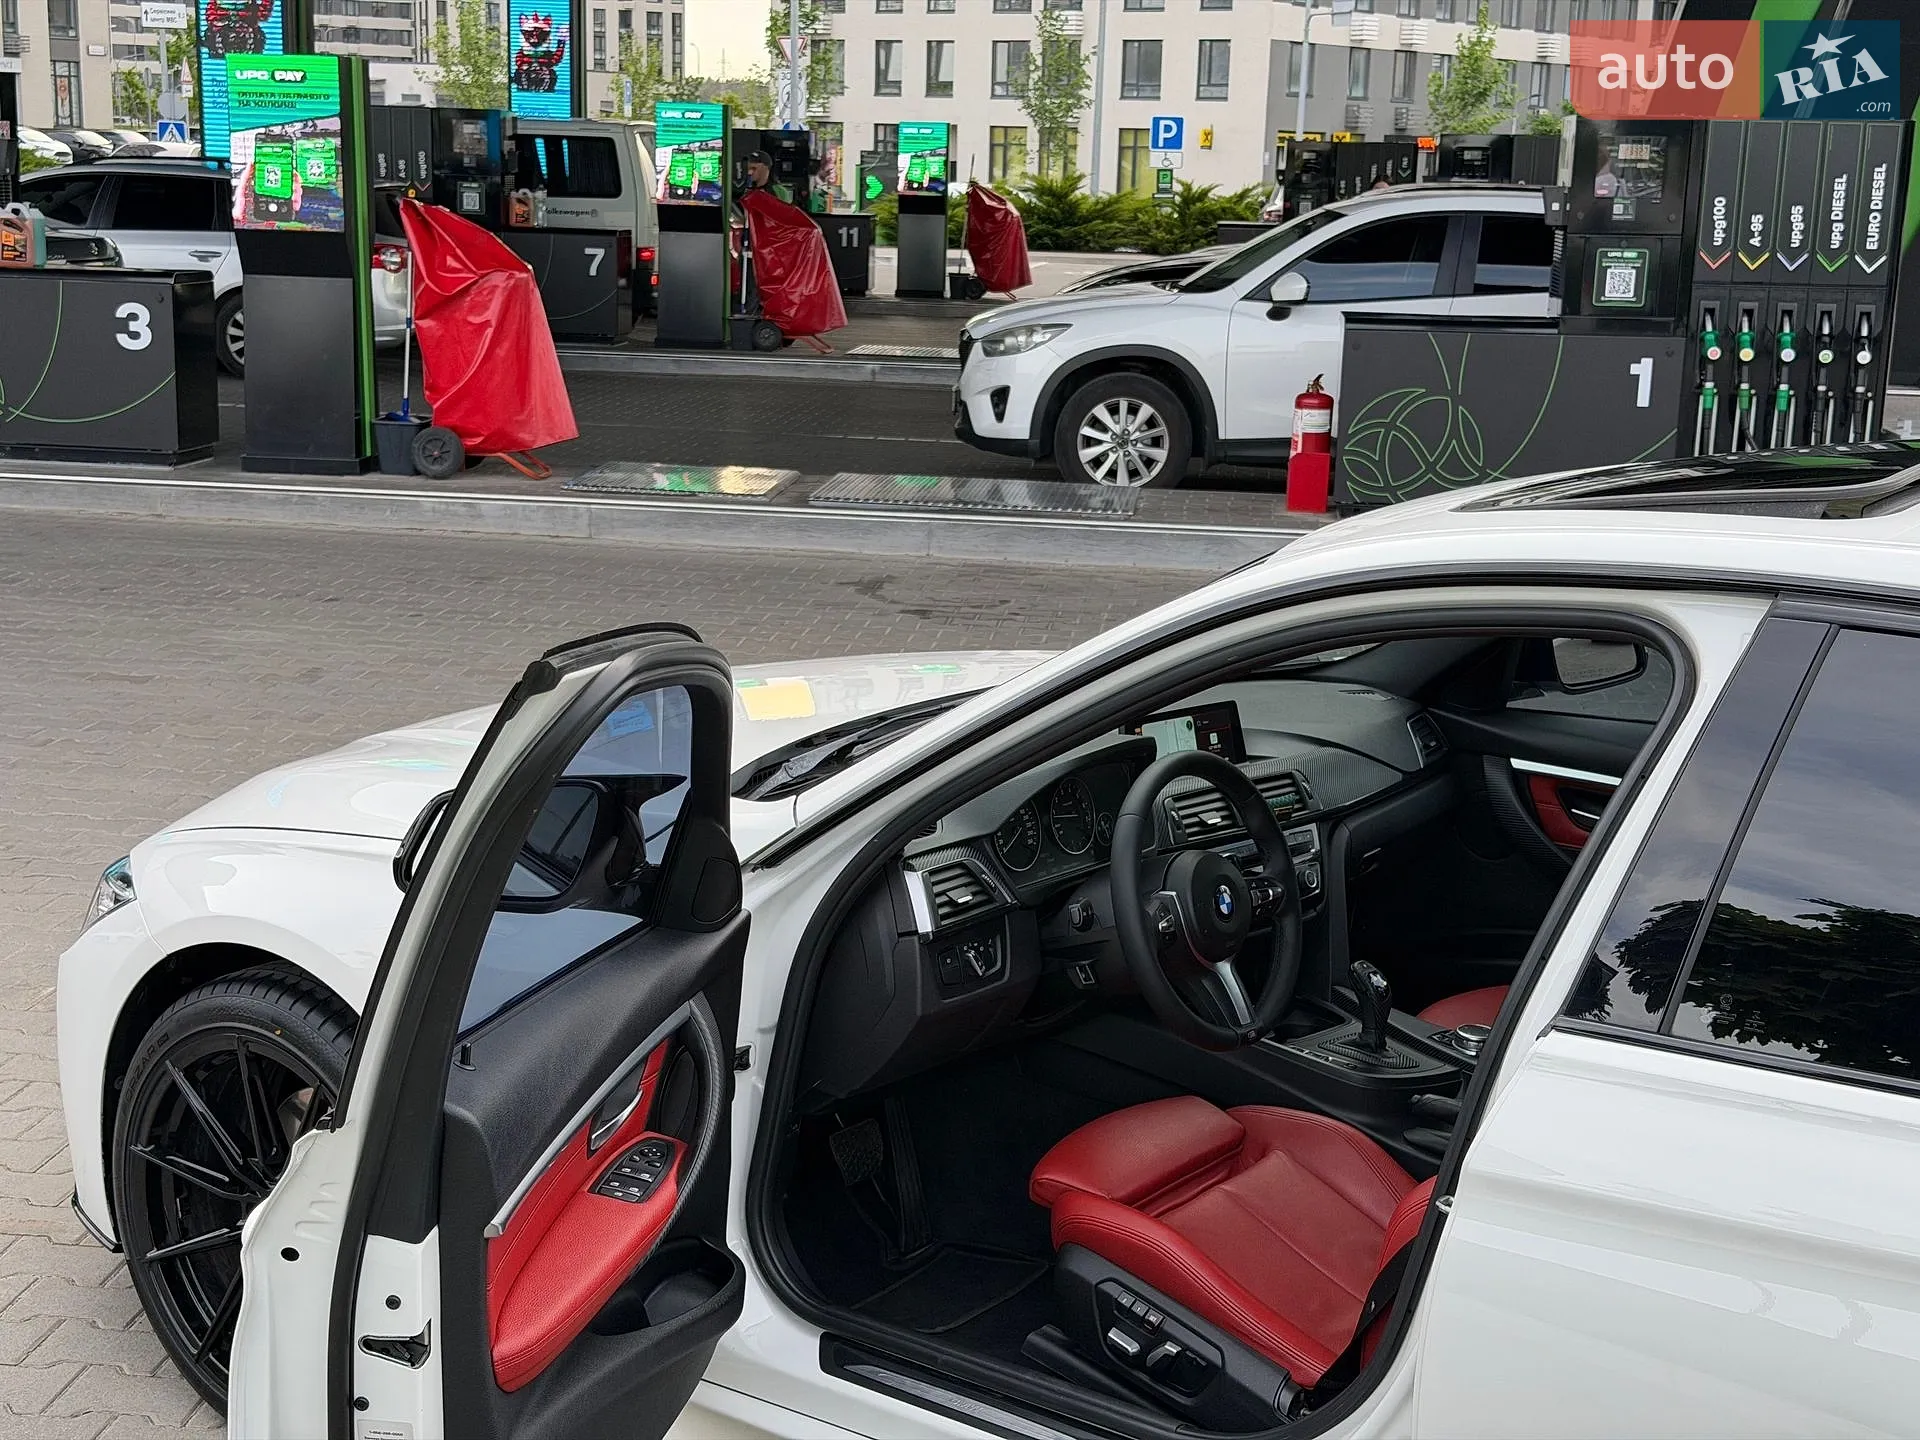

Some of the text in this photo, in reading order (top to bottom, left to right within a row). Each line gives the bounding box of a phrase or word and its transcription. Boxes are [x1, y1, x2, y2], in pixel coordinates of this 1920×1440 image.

[274, 70, 305, 82] PAY
[1158, 119, 1178, 148] P
[1713, 196, 1726, 246] upg100
[1790, 205, 1804, 248] upg95
[1830, 173, 1848, 249] upg DIESEL
[1866, 163, 1887, 250] EURO DIESEL
[838, 227, 858, 247] 11
[1749, 213, 1764, 247] A-95
[584, 247, 605, 276] 7
[115, 302, 152, 350] 3
[1630, 357, 1653, 407] 1
